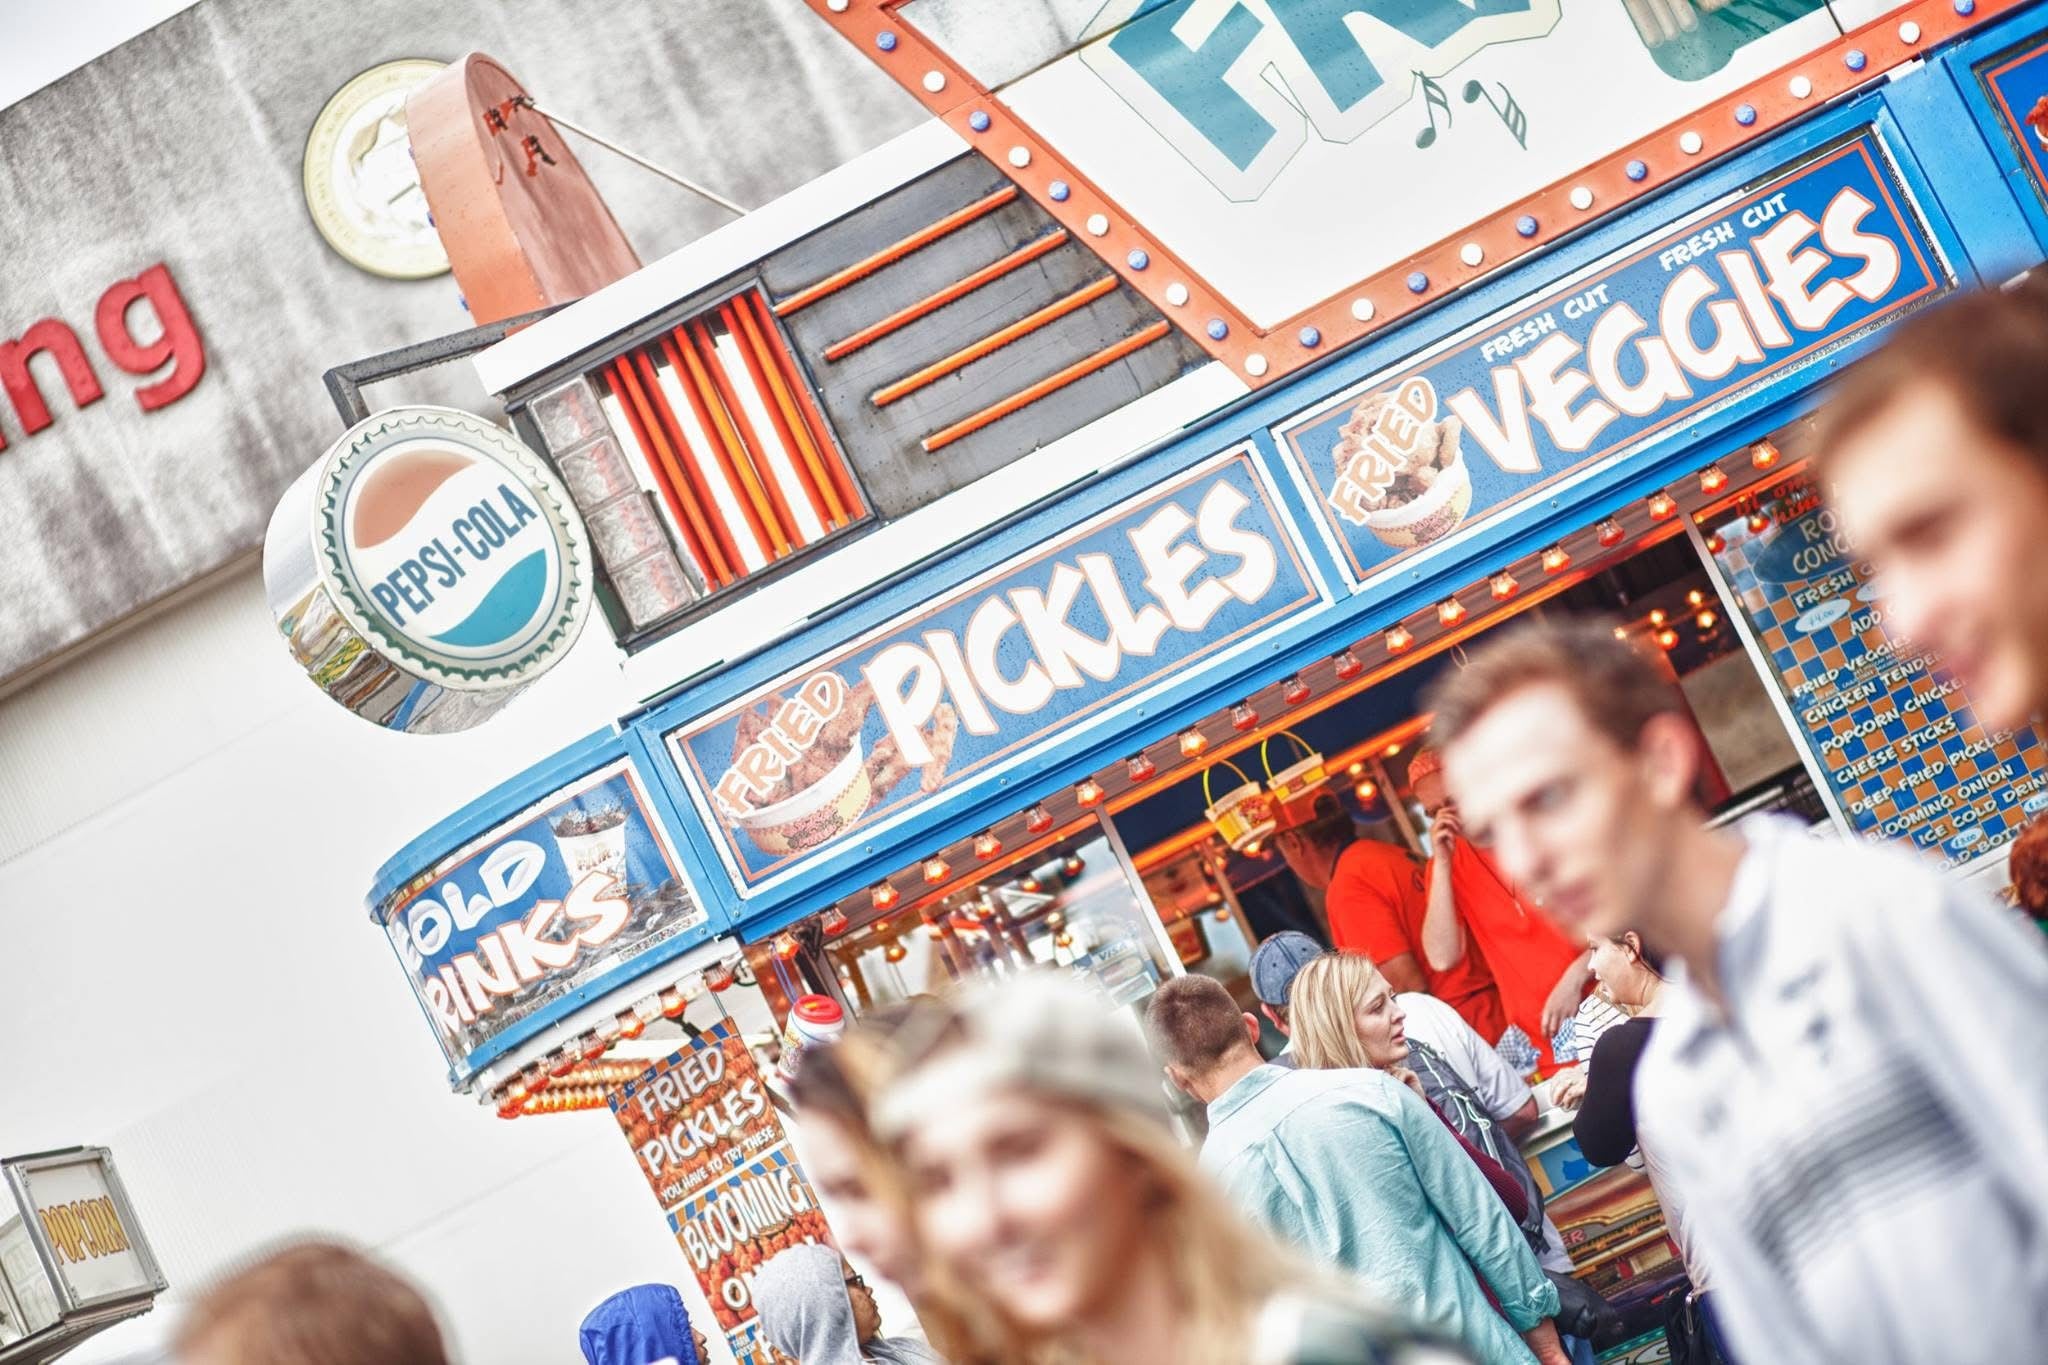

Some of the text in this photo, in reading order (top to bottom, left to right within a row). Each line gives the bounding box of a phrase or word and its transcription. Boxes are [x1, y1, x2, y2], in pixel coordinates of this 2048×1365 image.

[1658, 192, 1789, 272] FRESH CUT
[0, 262, 206, 452] ng
[1447, 186, 1901, 473] VEGGIES
[1480, 283, 1610, 363] FRESH CUT
[1329, 377, 1437, 525] FRIED
[371, 484, 538, 627] PEPSI-COLA
[1795, 571, 1855, 608] FRESH
[860, 480, 1277, 768] PICKLES
[1850, 610, 1881, 636] ADD
[1793, 668, 1839, 698] FRIED
[1844, 635, 1911, 673] VEGGIES
[1806, 682, 1877, 724] CHICKEN
[1880, 650, 1943, 687] TENDER
[714, 672, 843, 818] FRIED
[1820, 707, 1901, 755] POPCORN
[1904, 677, 1966, 714] CHICKE
[1836, 717, 1956, 784] CHEESE STICKS
[1852, 728, 2013, 816] DEEP FRIED PICKLES
[1866, 764, 2013, 842] BLOOMING ONION
[1918, 824, 1949, 845] ICE
[1953, 800, 1997, 828] COLD
[1936, 819, 2031, 873] OLD BOTT
[424, 870, 632, 1037] RINKS
[637, 1046, 726, 1122] FRIED
[640, 1079, 765, 1177] PICKLES
[661, 1125, 776, 1202] YOU HAVE TO TRY THESE
[39, 1194, 131, 1265] POPCORN
[682, 1168, 812, 1270] BLOOMING
